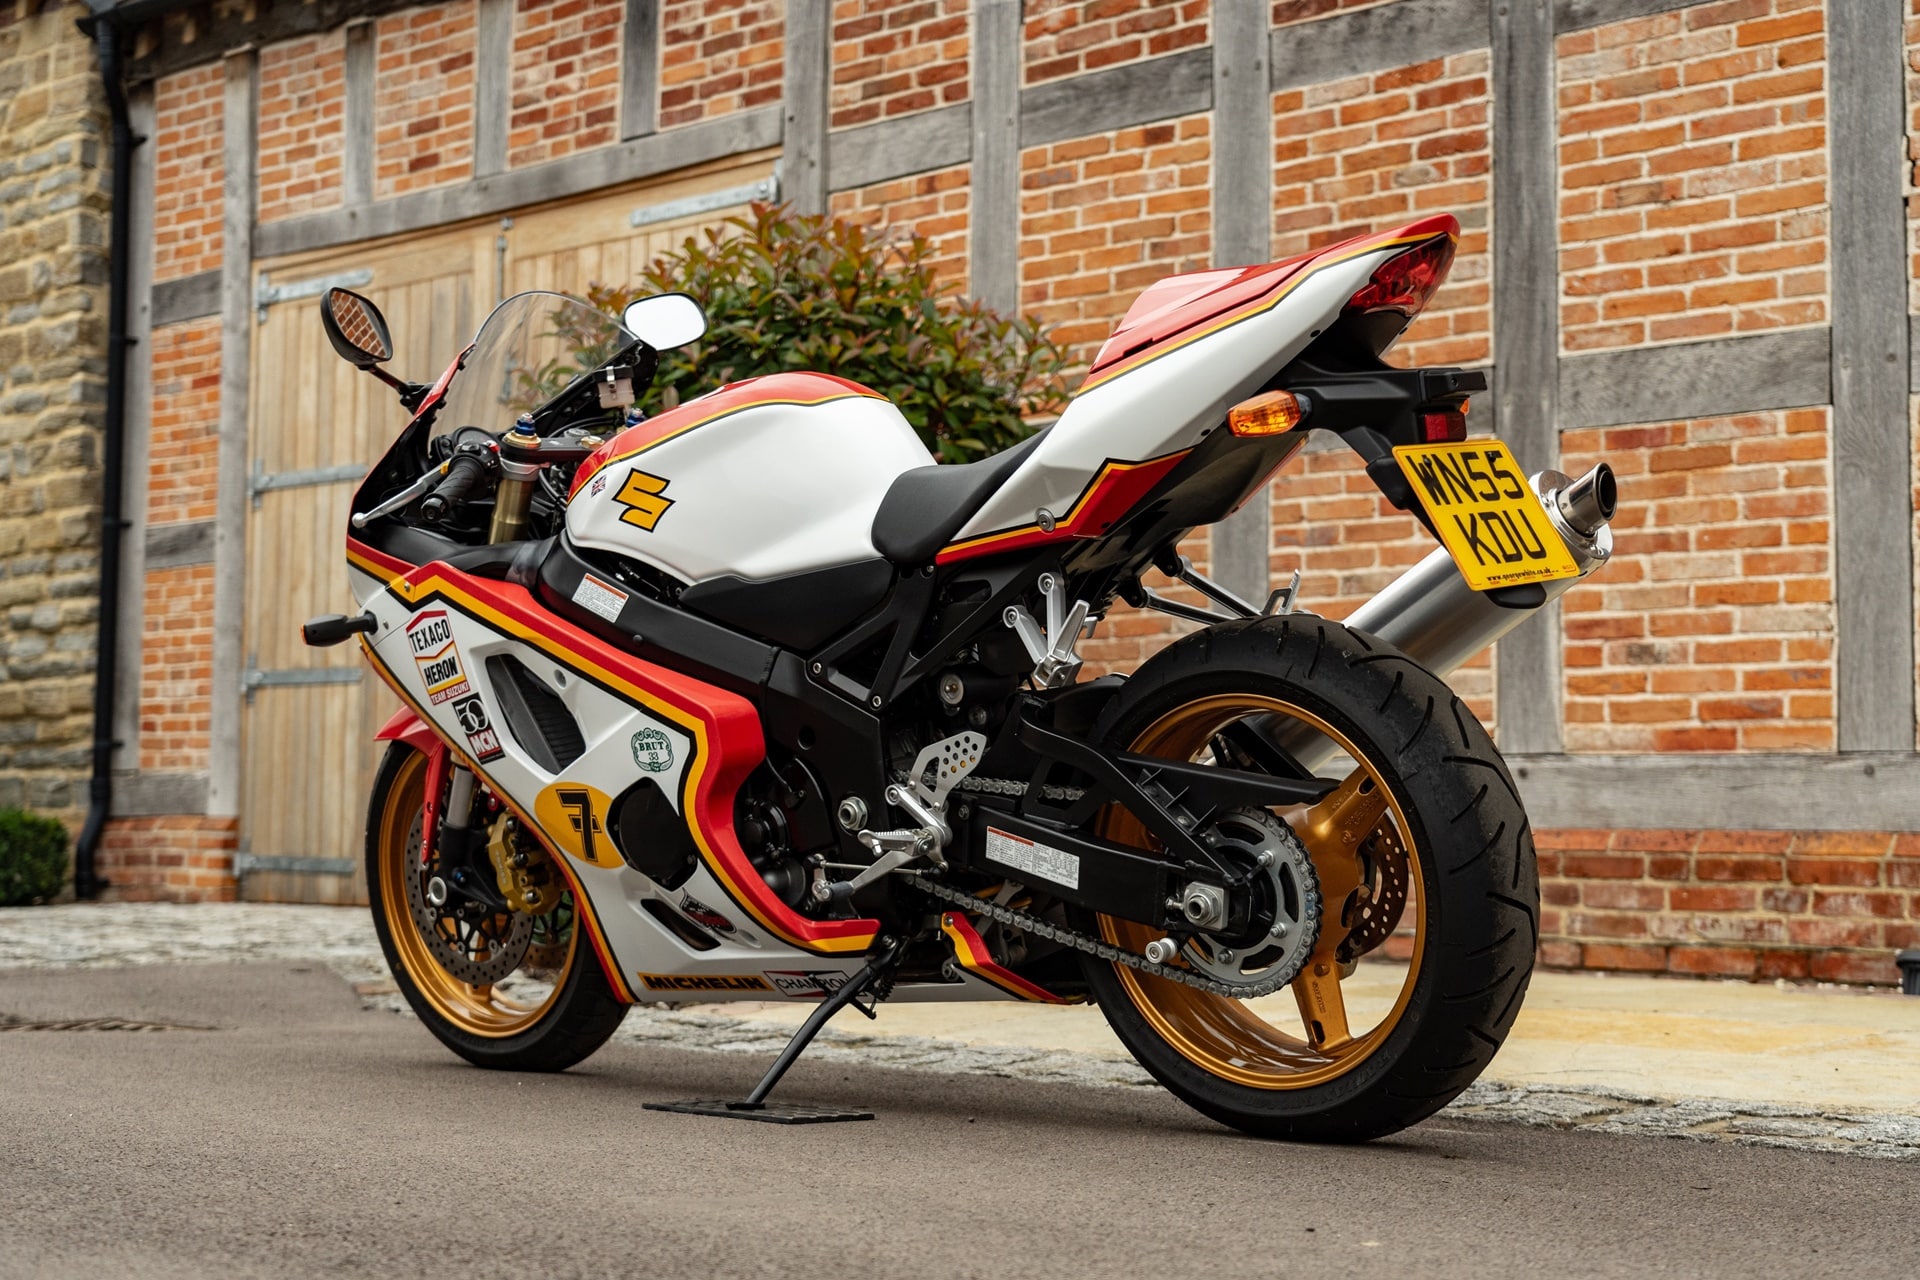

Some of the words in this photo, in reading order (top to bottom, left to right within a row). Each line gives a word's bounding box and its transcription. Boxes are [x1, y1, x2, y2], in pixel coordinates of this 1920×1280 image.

[1405, 450, 1525, 506] WN55
[1453, 508, 1547, 566] KDU
[409, 618, 450, 653] TEXACO
[424, 656, 458, 686] HERON
[430, 690, 447, 705] TEAM
[446, 681, 470, 699] SUZUKI
[455, 699, 489, 734] 50
[470, 729, 500, 755] MCN
[638, 741, 665, 752] BRUT
[648, 751, 659, 761] 33
[556, 789, 603, 862] 7
[643, 975, 766, 991] MICHELIN
